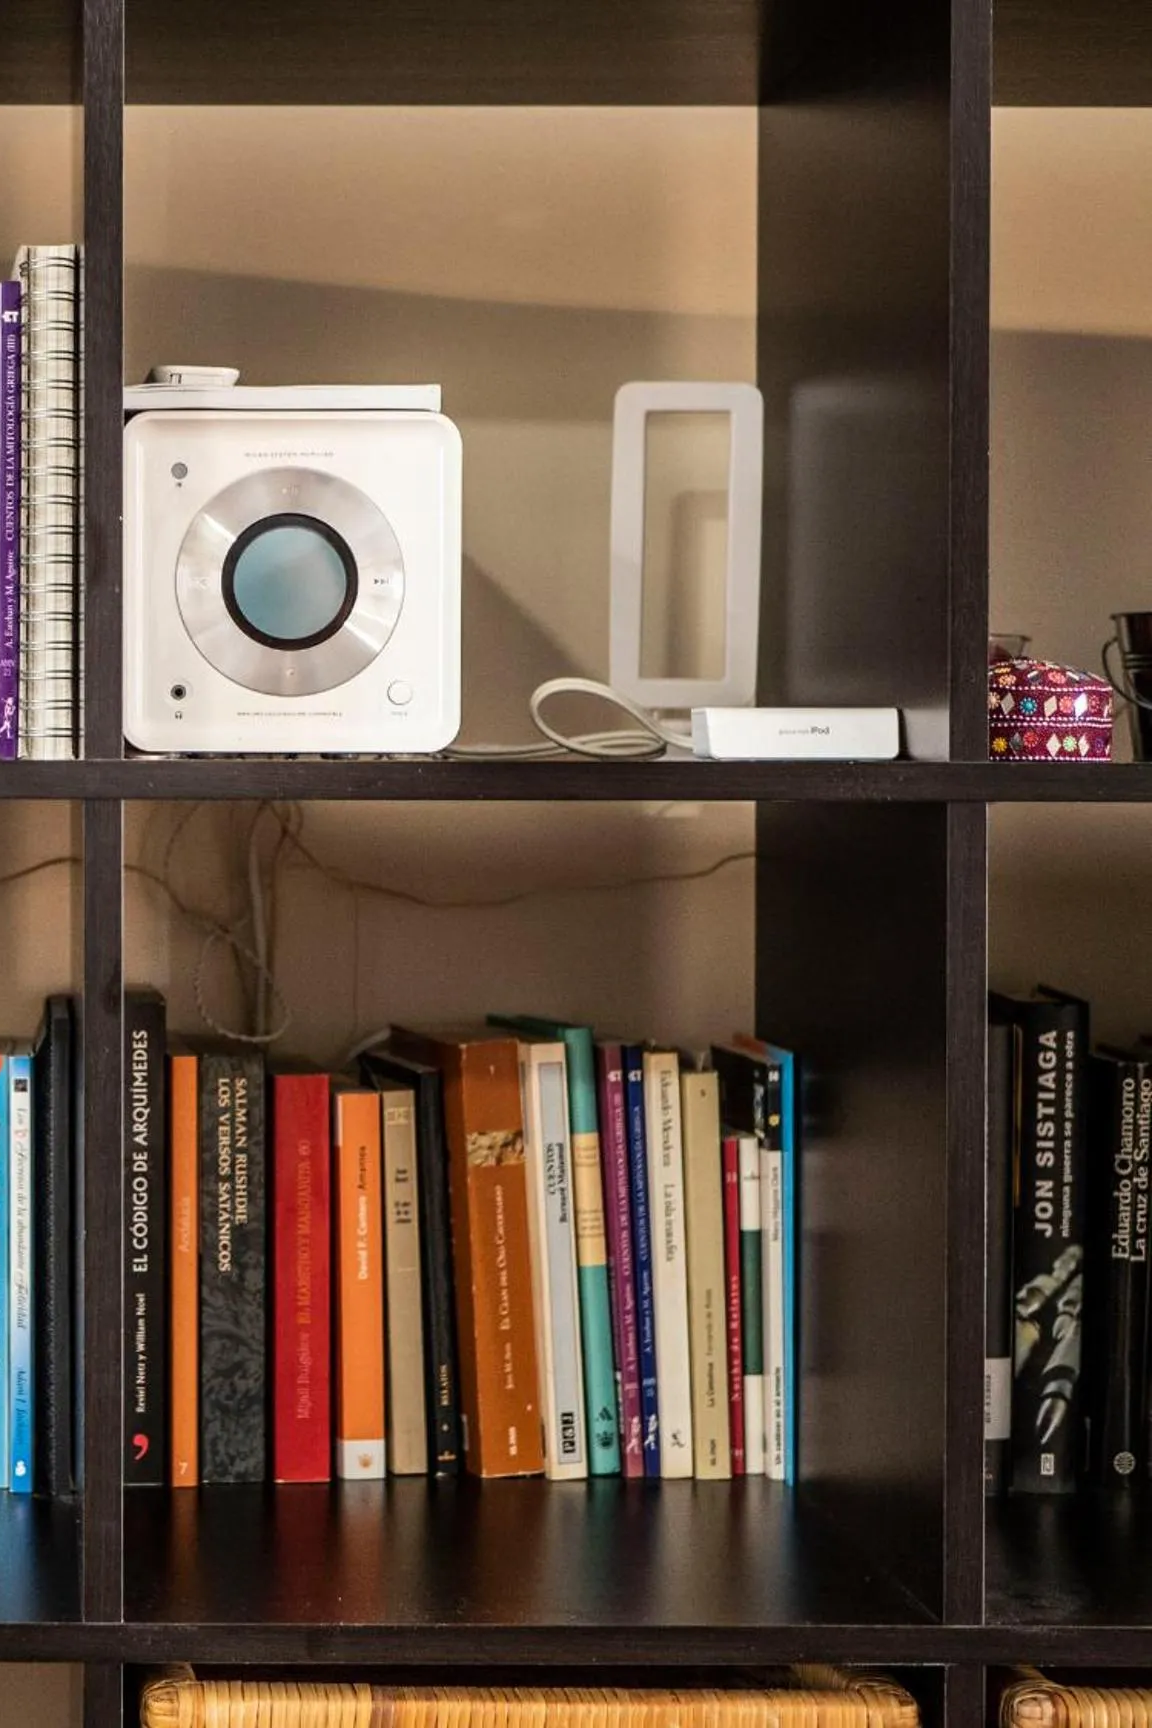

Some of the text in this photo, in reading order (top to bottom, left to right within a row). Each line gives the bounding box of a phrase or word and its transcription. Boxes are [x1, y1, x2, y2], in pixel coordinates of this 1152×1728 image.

[5, 353, 16, 393] GRIEGA
[3, 394, 16, 456] MITOLOGÍA
[4, 472, 15, 487] DE
[5, 456, 15, 470] LA
[4, 490, 15, 541] CUENTOS
[1064, 1030, 1075, 1058] otra
[129, 1029, 151, 1147] ARQUÍMEDES
[659, 1069, 673, 1117] Eduardo
[1063, 1072, 1076, 1118] parece
[235, 1077, 248, 1224] SALMAN RUSHDIE
[661, 1118, 674, 1167] Mendoza
[1034, 1029, 1058, 1239] JON SISTIAGA
[1063, 1123, 1072, 1137] se
[132, 1151, 148, 1173] DE
[218, 1077, 234, 1272] LOS VERSOS SATÁNICOS
[545, 1143, 557, 1196] CUENTOS
[1062, 1138, 1074, 1183] guerra
[1111, 1077, 1136, 1259] Eduardo Chamorro
[1129, 1078, 1152, 1262] La cruz de Santiago
[128, 1176, 149, 1250] CÓDIGO
[664, 1183, 676, 1199] La
[1060, 1185, 1073, 1238] ninguna
[132, 1254, 148, 1273] EL
[134, 1293, 146, 1316] Noel
[134, 1319, 146, 1353] William
